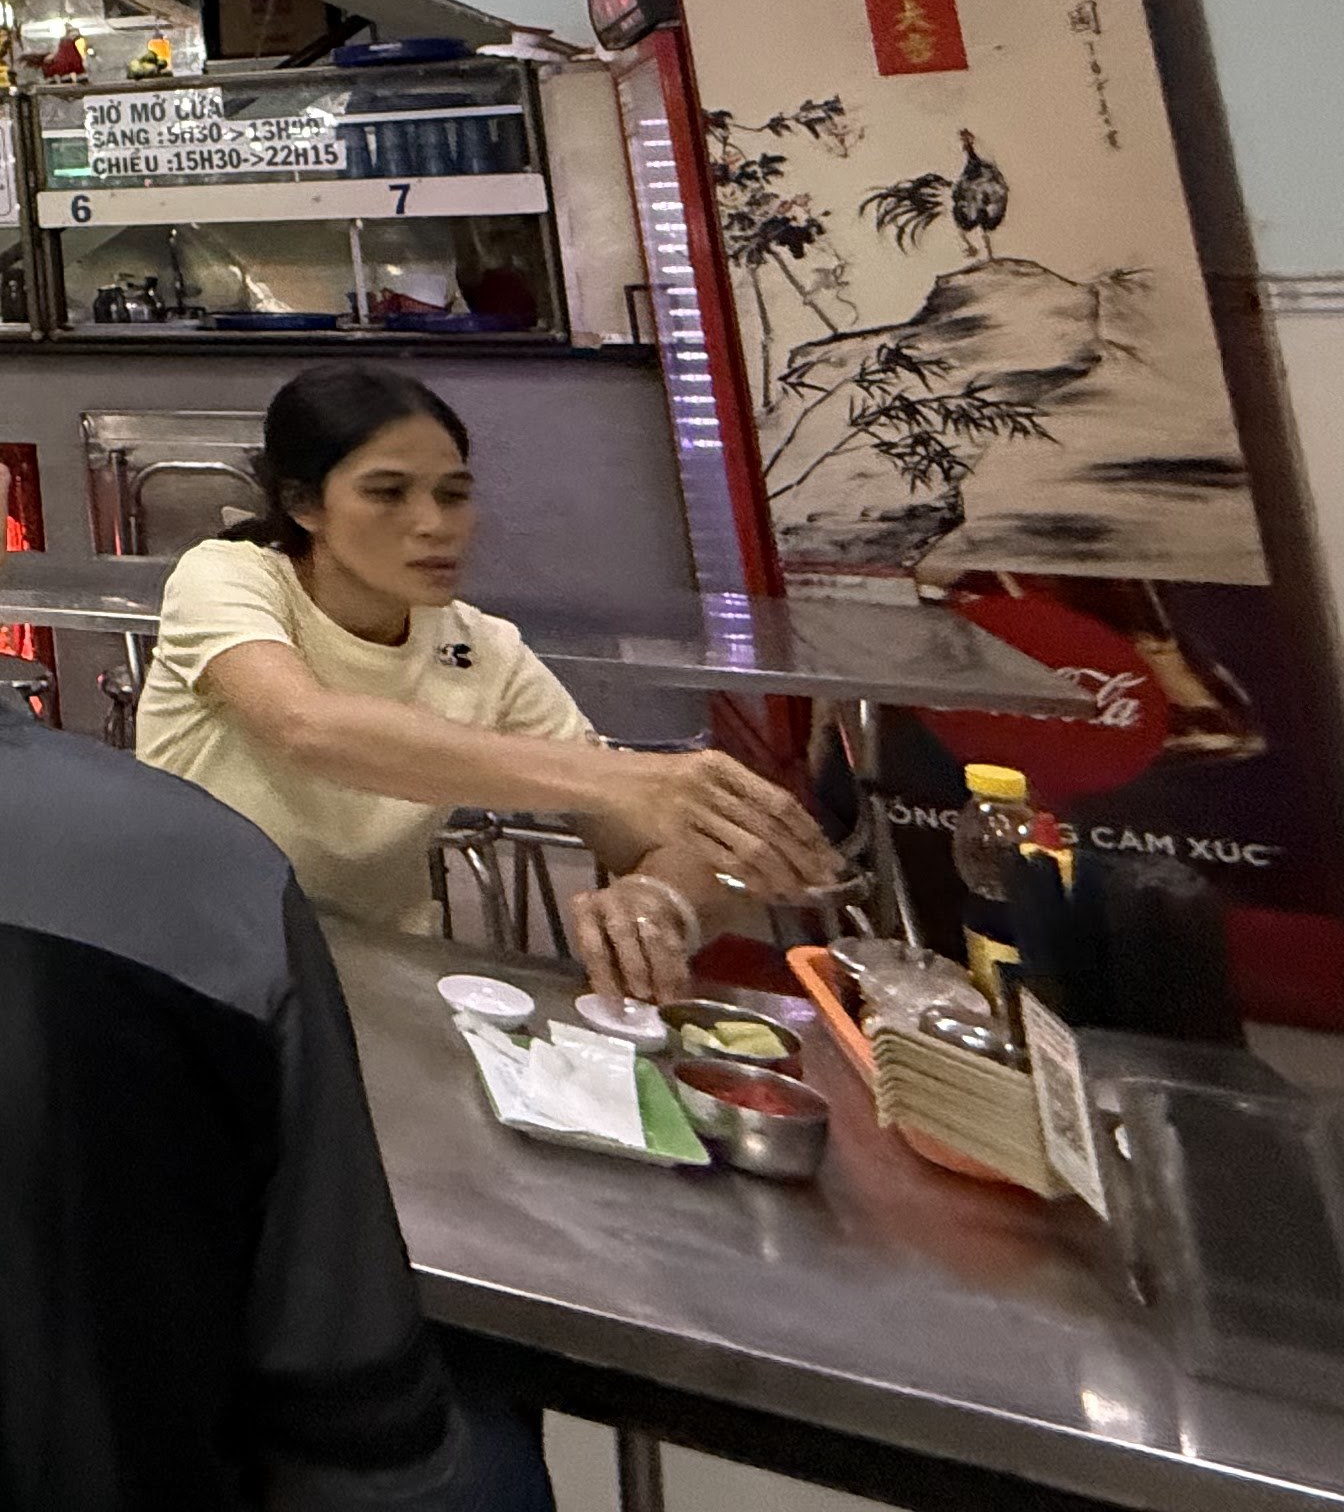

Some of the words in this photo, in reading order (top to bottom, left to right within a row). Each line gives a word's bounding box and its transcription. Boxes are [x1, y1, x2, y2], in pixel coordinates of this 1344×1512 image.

[130, 93, 166, 123] MỞ
[71, 195, 92, 223] 6
[389, 184, 411, 214] 7
